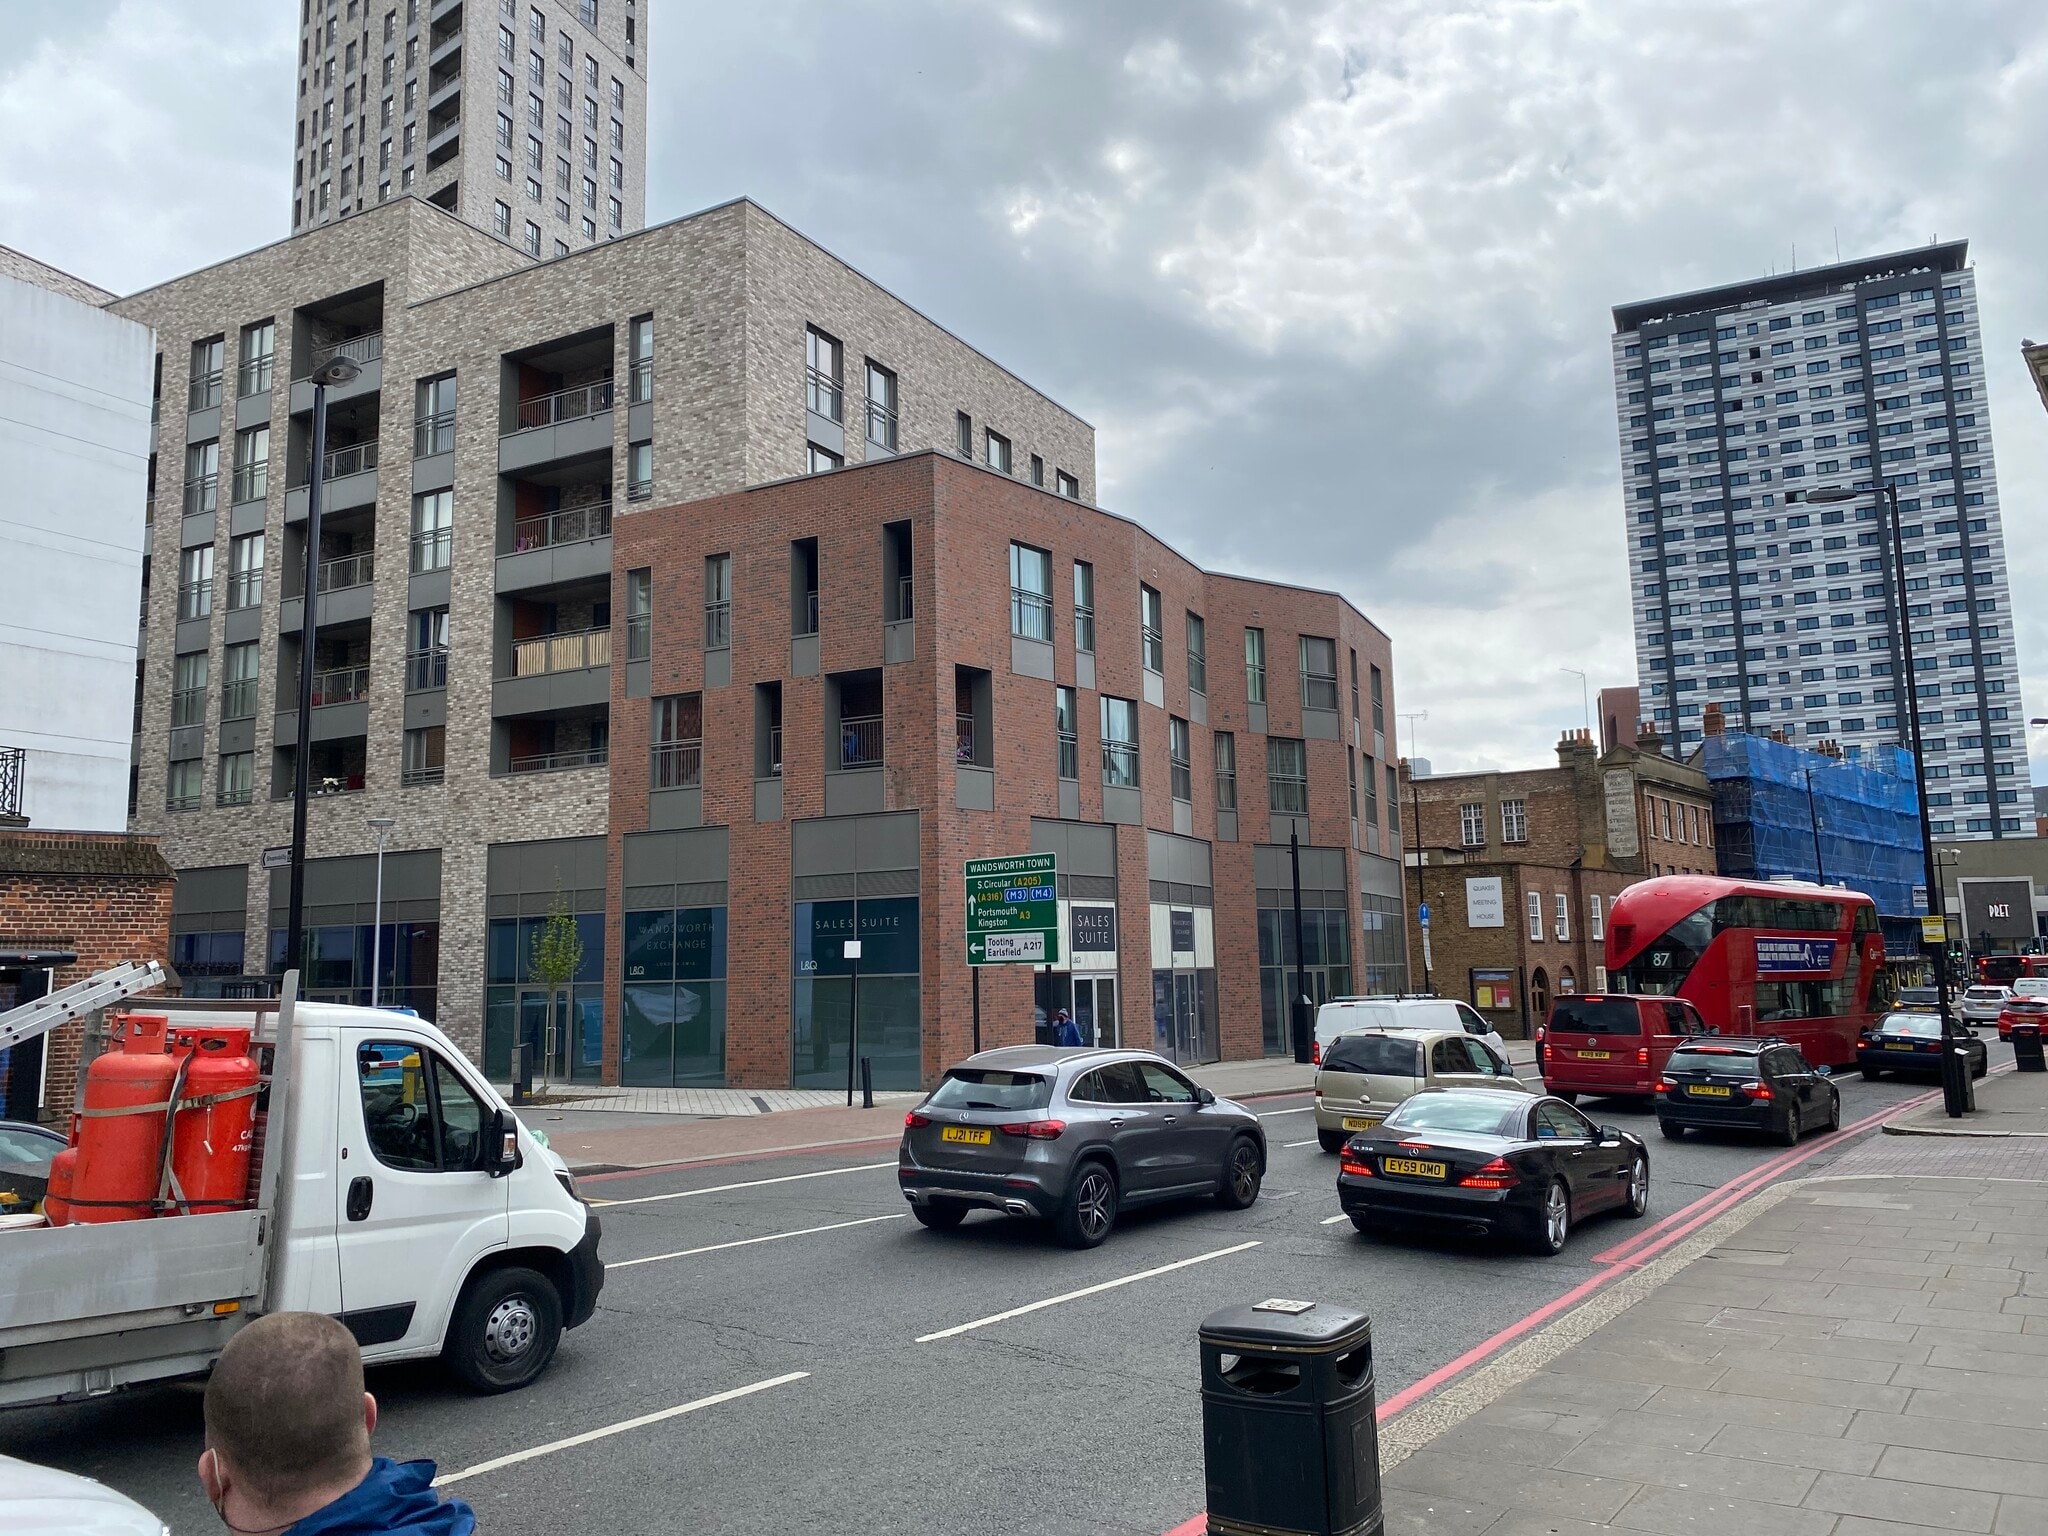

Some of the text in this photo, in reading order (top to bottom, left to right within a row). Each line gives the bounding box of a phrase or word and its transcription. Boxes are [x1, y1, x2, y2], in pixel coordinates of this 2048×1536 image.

[970, 858, 1050, 873] WANDSWORTH TOWN
[977, 876, 1042, 890] S.Circular (A205)
[1472, 884, 1496, 892] QUAKER
[977, 888, 1053, 903] (A316) (M3) (M4)
[978, 906, 1018, 917] Portsmouth
[1020, 911, 1031, 920] A3
[1988, 904, 2010, 918] PRET
[815, 917, 900, 930] SALES SUITE
[978, 918, 1008, 928] Kingston
[1077, 914, 1109, 927] SALES
[988, 938, 1014, 948] Tooting
[1079, 931, 1108, 944] SUITE
[646, 939, 706, 950] EXCHANGE
[1024, 942, 1042, 951] A217
[988, 948, 1022, 957] Earlsfield
[800, 960, 818, 971] L&Q
[1652, 952, 1670, 967] 87
[630, 966, 645, 976] L&Q
[947, 1129, 985, 1142] LJ21 TFF
[1390, 1160, 1441, 1175] EY59 OMO
